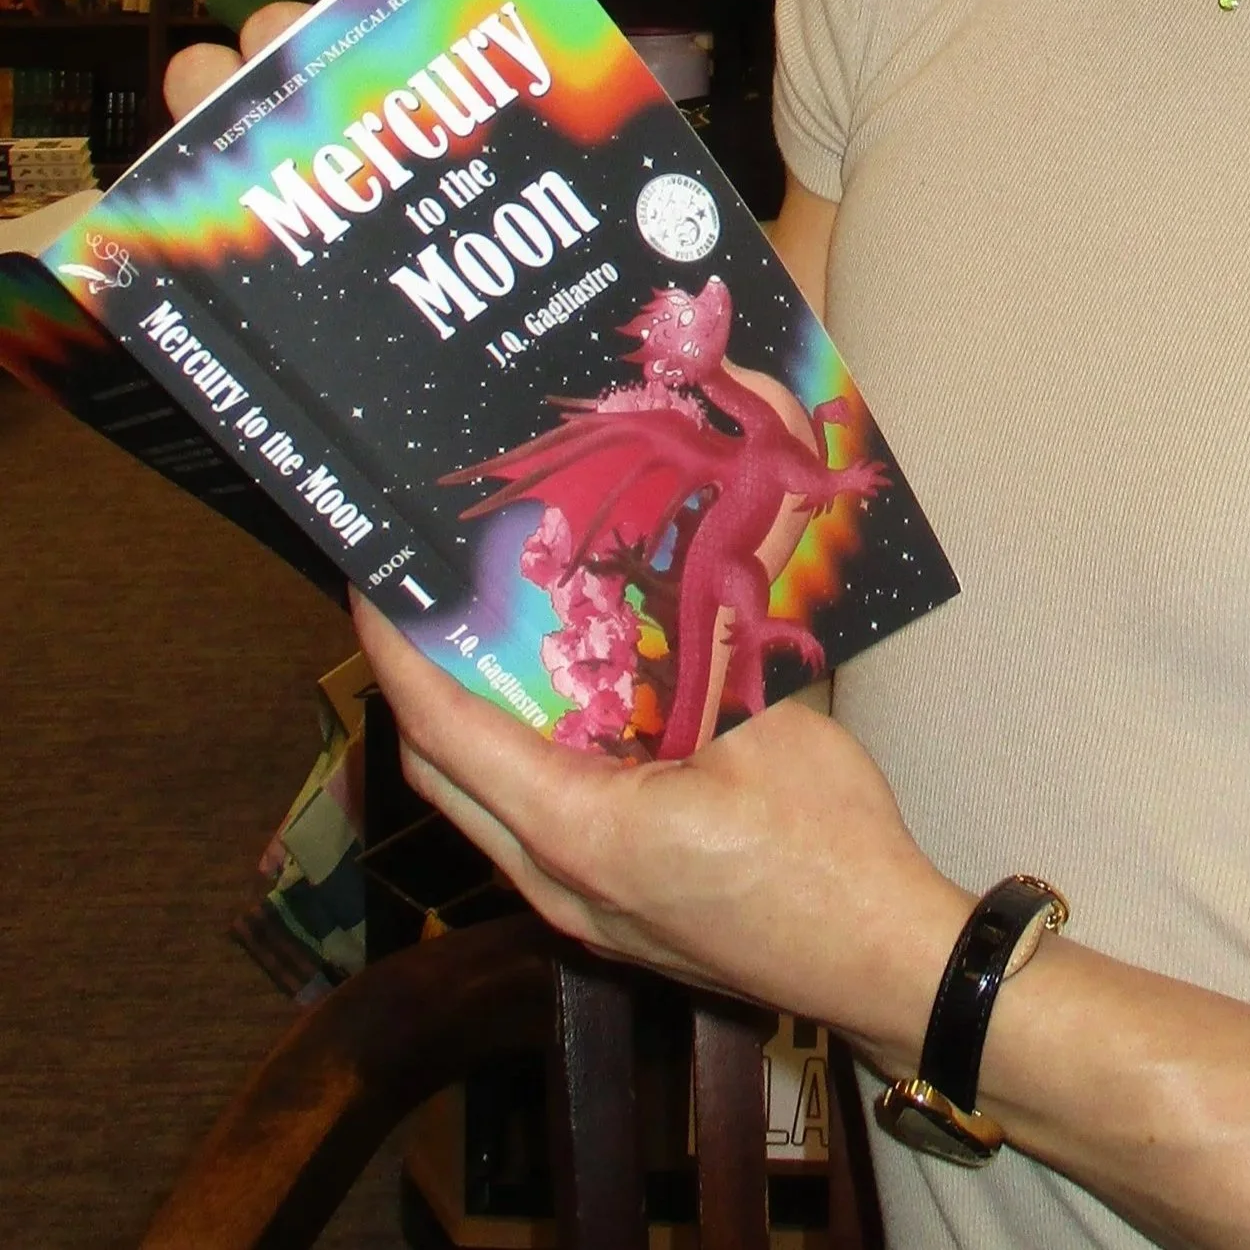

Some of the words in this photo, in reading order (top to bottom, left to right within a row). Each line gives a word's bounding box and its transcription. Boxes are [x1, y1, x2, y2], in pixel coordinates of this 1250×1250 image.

[212, 73, 310, 153] BESTSELLER
[304, 58, 327, 79] IN
[320, 6, 392, 67] MAGICAL
[238, 1, 552, 268] Mercury
[405, 197, 447, 236] to
[438, 158, 497, 210] the
[388, 170, 600, 341] Moon
[485, 331, 530, 369] J.Q.
[524, 262, 620, 337] Gagliastro
[139, 300, 249, 413] Mercury
[235, 406, 269, 439] to
[259, 431, 305, 477] the
[296, 464, 374, 547] Moon
[368, 545, 416, 586] BOOK
[399, 574, 437, 610] 1
[444, 623, 480, 659] J.Q.
[476, 653, 549, 728] Gagliastro
